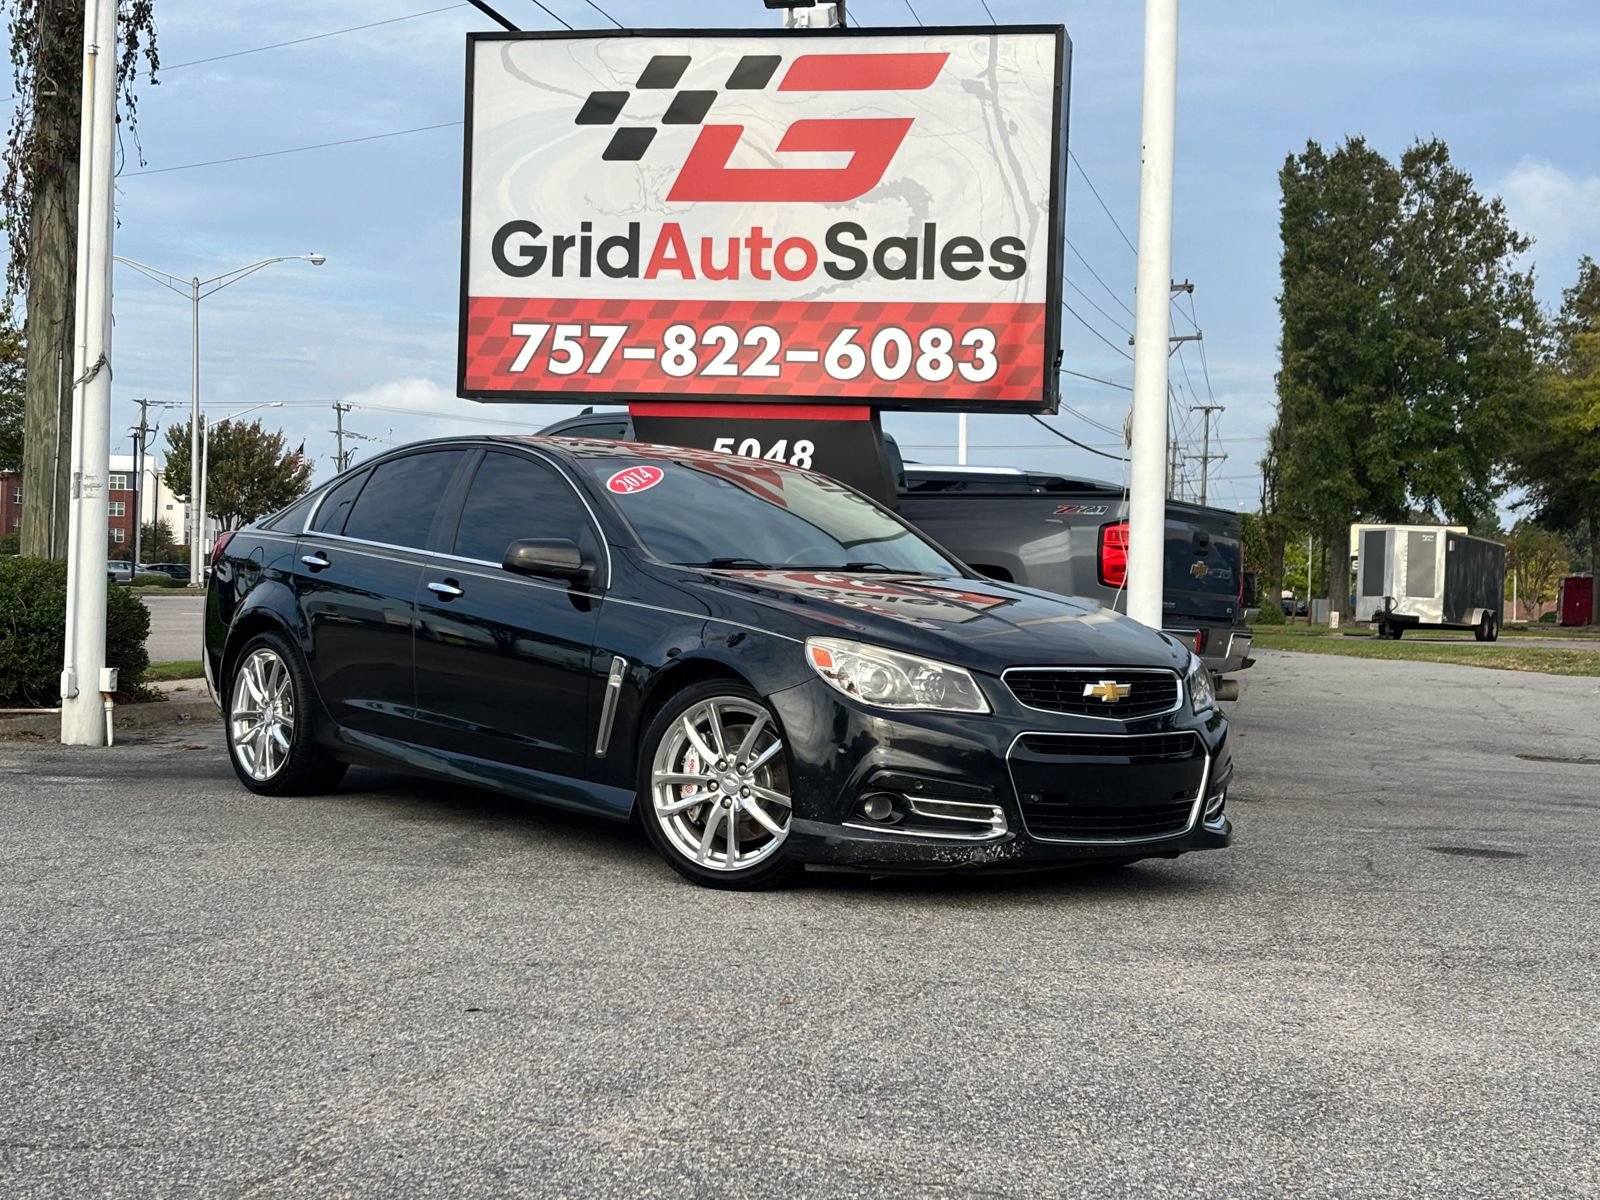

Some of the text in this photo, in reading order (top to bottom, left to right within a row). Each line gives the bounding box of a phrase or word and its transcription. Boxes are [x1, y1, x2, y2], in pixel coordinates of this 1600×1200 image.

[508, 322, 999, 383] 757-822-6083
[615, 467, 654, 492] 2014
[1053, 505, 1109, 515] Z71
